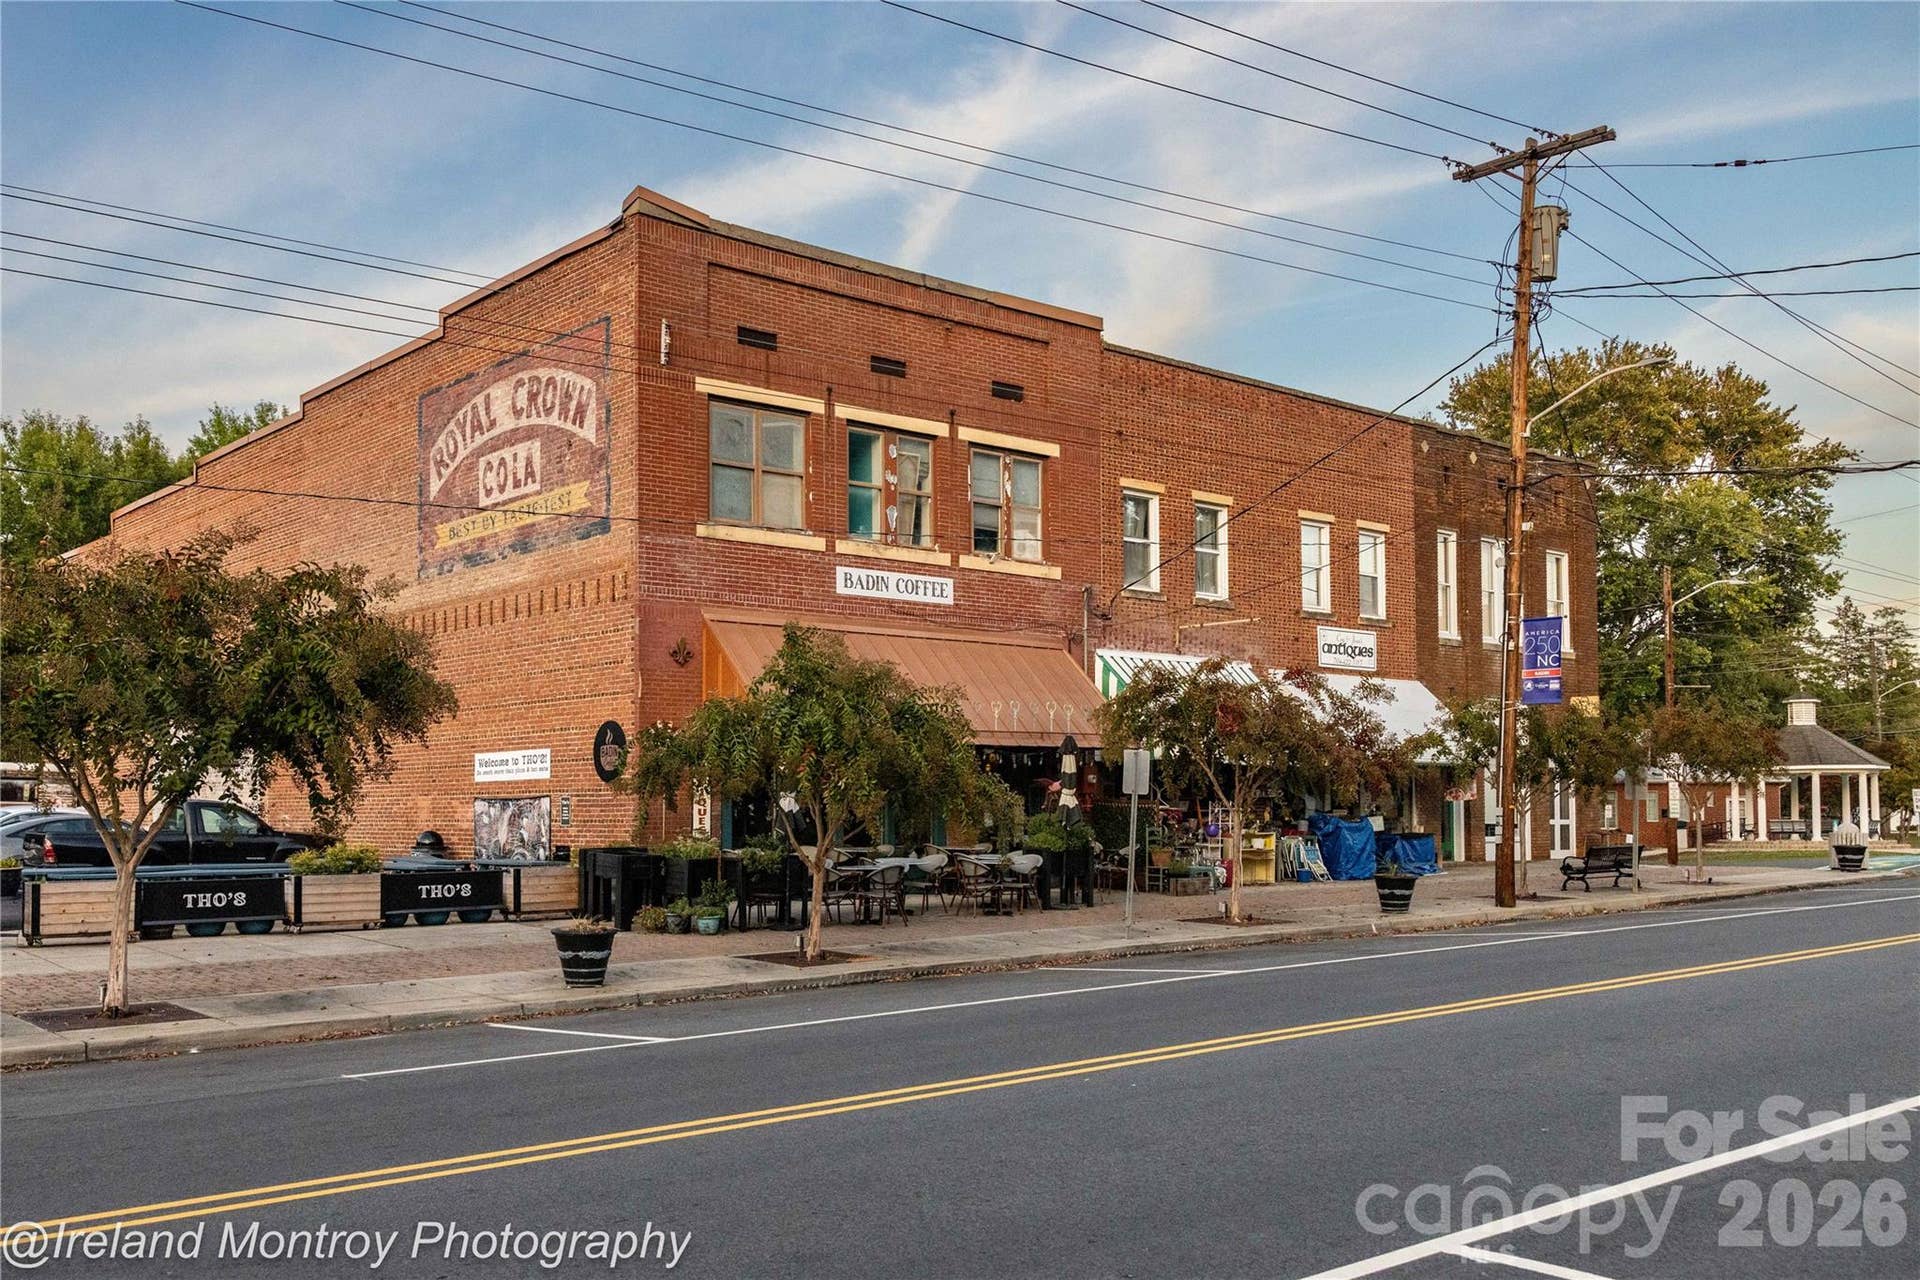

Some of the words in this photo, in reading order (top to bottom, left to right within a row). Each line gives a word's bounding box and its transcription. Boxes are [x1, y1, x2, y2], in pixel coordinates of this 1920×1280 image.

[433, 392, 497, 481] ROYAL
[511, 374, 592, 430] CROWN
[482, 449, 537, 499] COLA
[448, 520, 477, 540] BEST
[482, 514, 496, 530] BY
[843, 571, 890, 593] BADIN
[895, 577, 949, 599] COFFEE
[1322, 642, 1374, 660] antiques
[1524, 635, 1560, 656] 250
[1536, 653, 1560, 667] NC
[478, 757, 509, 769] Welcome
[511, 757, 519, 766] to
[183, 891, 247, 909] THO'S
[418, 883, 472, 899] THO'S
